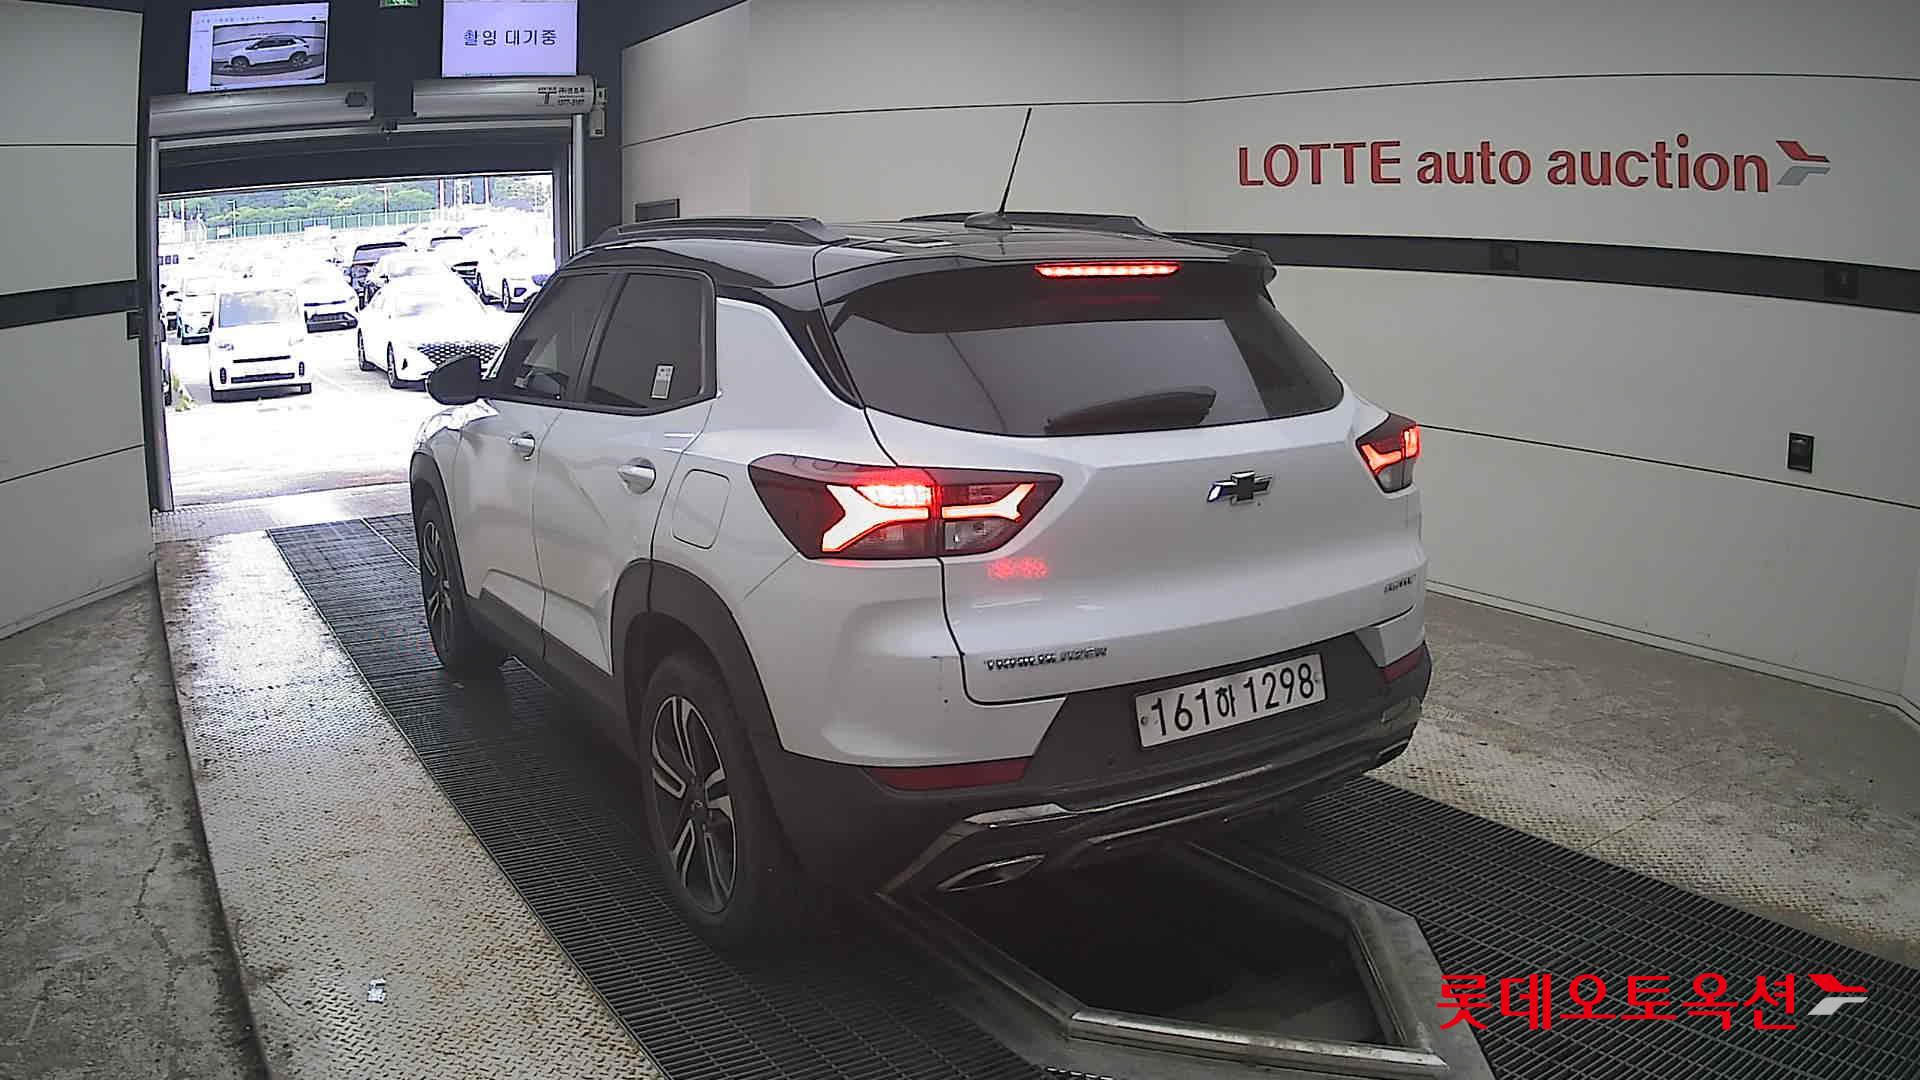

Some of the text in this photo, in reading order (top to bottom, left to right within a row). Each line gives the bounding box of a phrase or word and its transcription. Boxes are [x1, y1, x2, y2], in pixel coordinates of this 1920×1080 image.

[505, 29, 557, 46] 대기중
[1239, 133, 1769, 192] LOTTE auto auction
